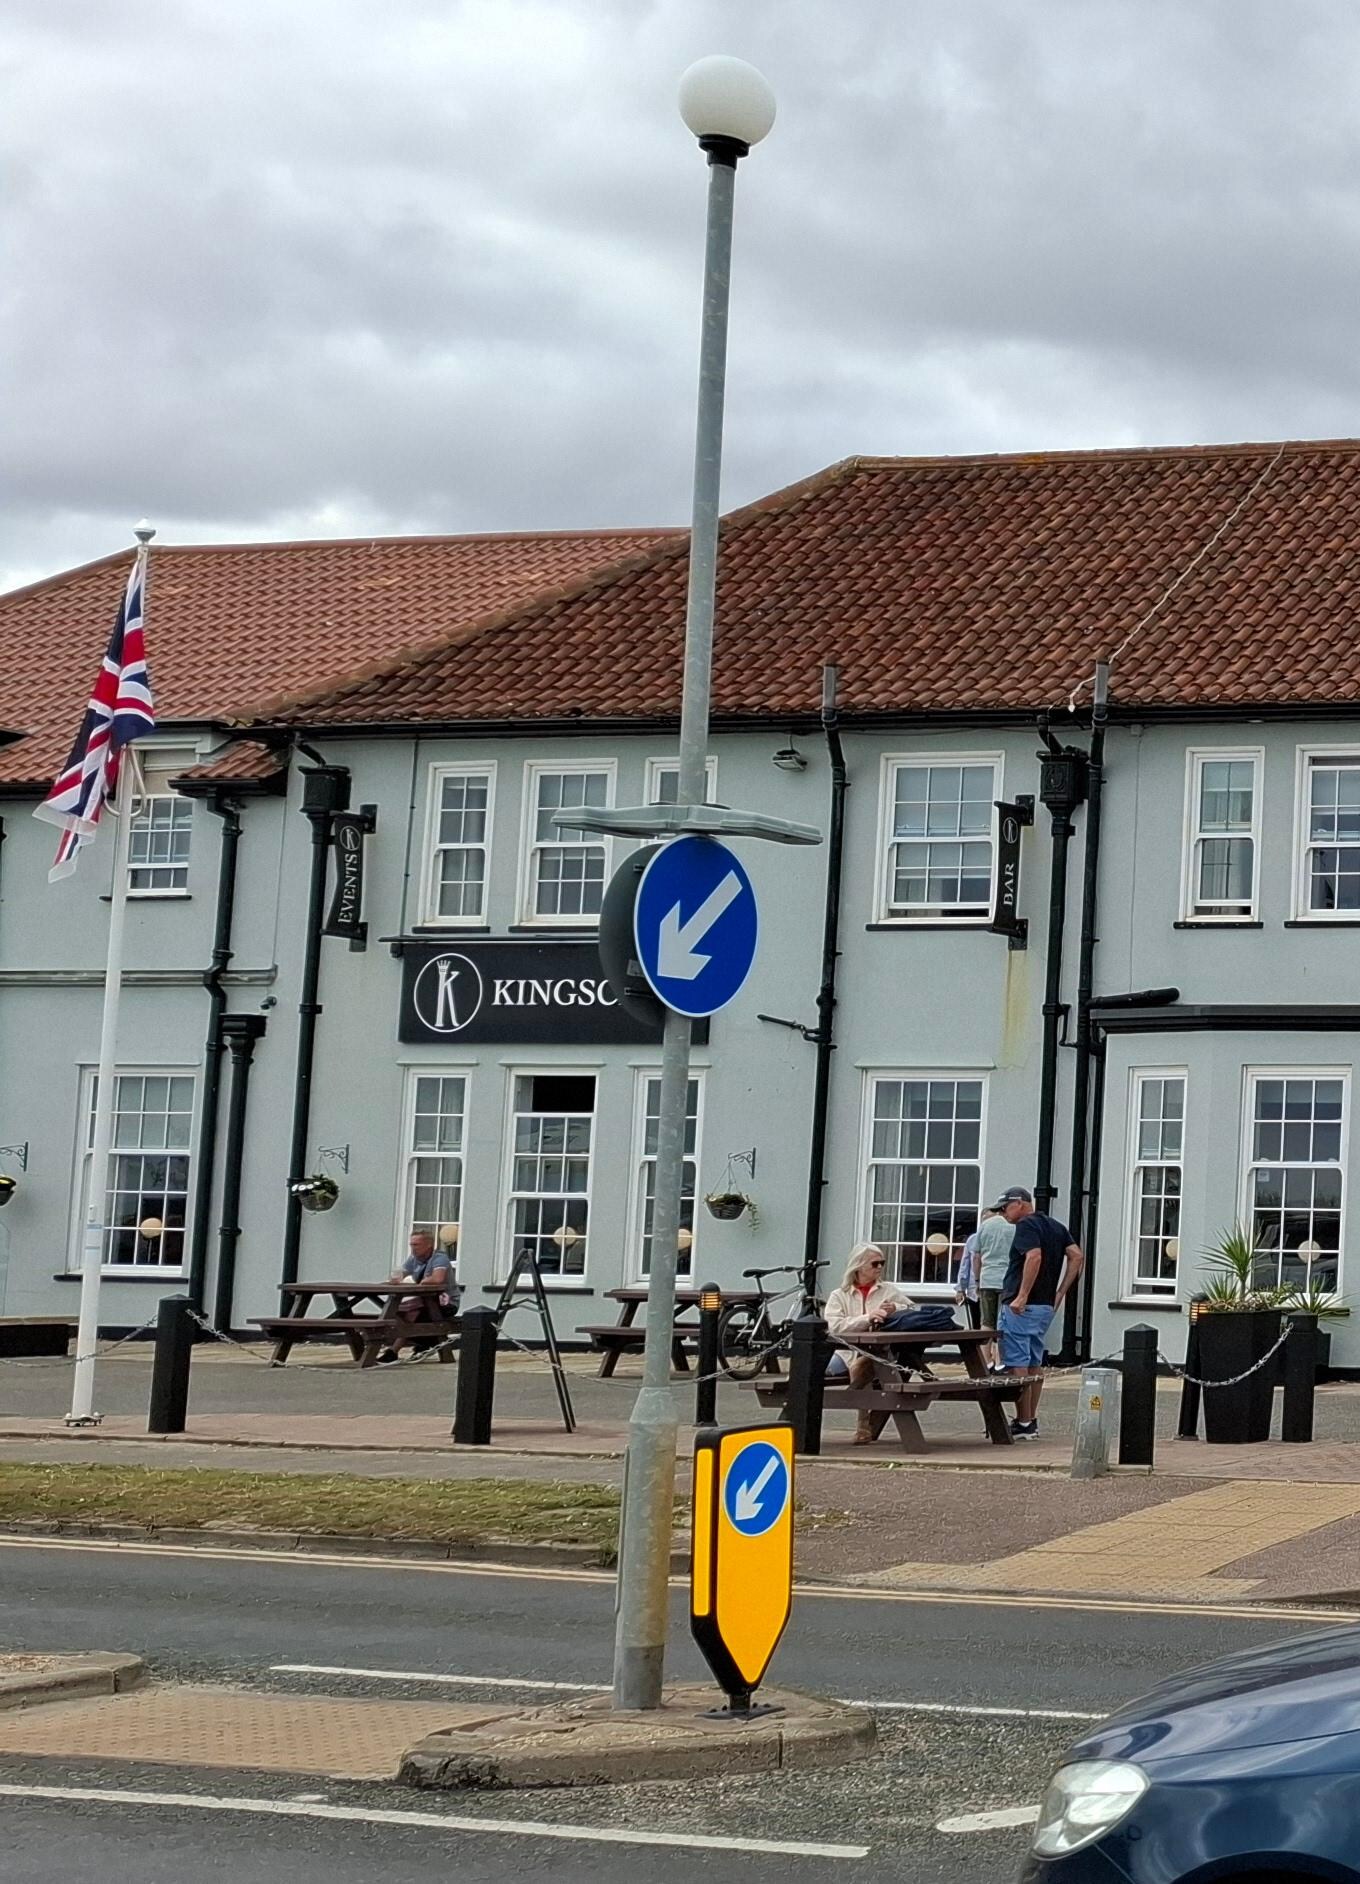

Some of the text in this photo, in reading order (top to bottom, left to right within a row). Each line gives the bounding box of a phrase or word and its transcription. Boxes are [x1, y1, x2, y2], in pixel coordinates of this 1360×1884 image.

[338, 853, 358, 922] EVENTS
[1003, 863, 1014, 905] BAR
[491, 979, 621, 1006] KINGSC
